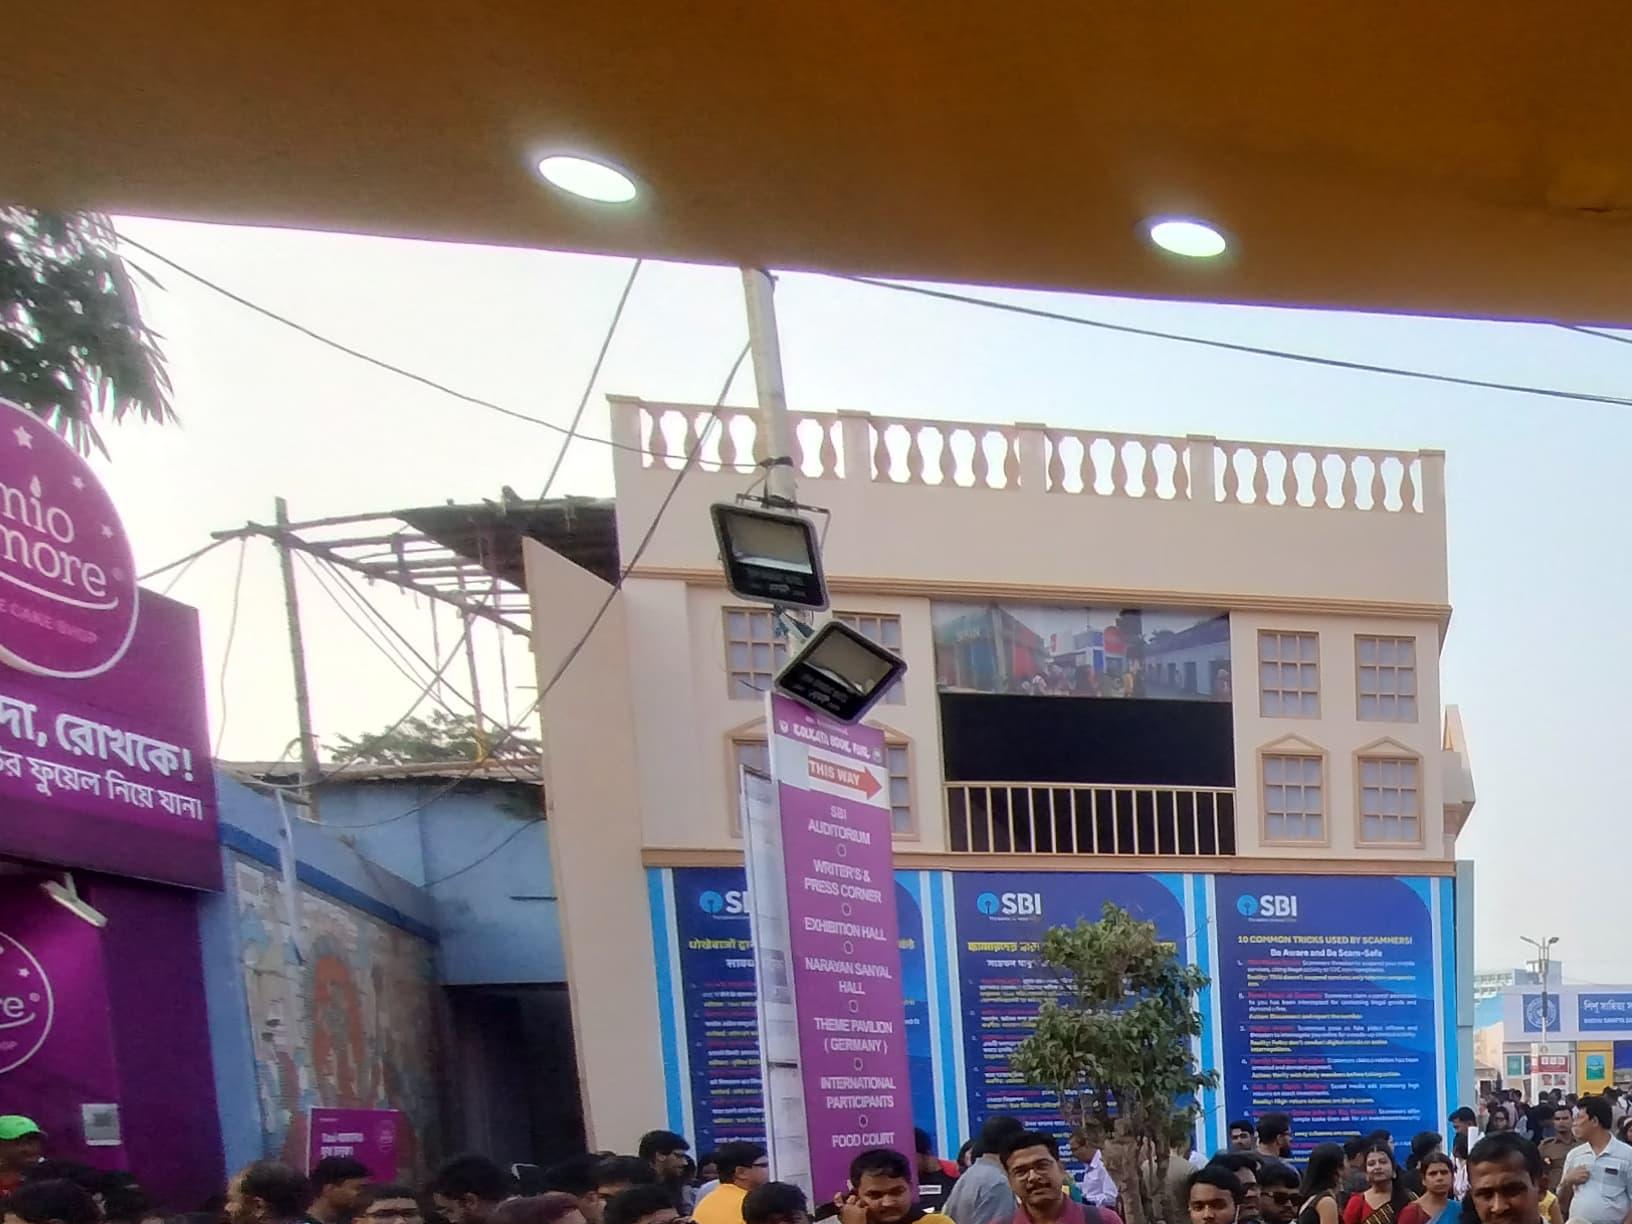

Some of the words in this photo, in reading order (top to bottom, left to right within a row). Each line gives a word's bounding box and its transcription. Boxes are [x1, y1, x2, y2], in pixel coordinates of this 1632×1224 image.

[809, 760, 835, 779] THIS
[837, 767, 860, 786] WAY
[830, 805, 847, 820] SBI
[808, 819, 871, 845] AUDITORIUM
[804, 877, 839, 896] PRESS
[841, 884, 882, 903] CORNER
[1002, 893, 1041, 914] SBI
[1260, 895, 1297, 917] SBI
[804, 917, 860, 937] EXHIBITION
[862, 926, 887, 941] HALL
[1238, 935, 1249, 944] 10
[1250, 935, 1291, 944] COMMON
[1292, 935, 1324, 944] TRICKS
[1325, 936, 1349, 944] USED
[1350, 936, 1360, 944] BY
[1310, 948, 1325, 957] and
[805, 957, 854, 974] NARAYAN
[855, 964, 892, 978] SANYAL
[839, 981, 865, 994] HALL
[814, 1017, 851, 1031] THEME
[851, 1020, 892, 1034] PAVILION
[820, 1077, 896, 1089] INTERNATIONAL
[826, 1095, 894, 1108] PARTICIPANTS
[832, 1134, 861, 1147] FOOD
[862, 1132, 895, 1145] COURT
